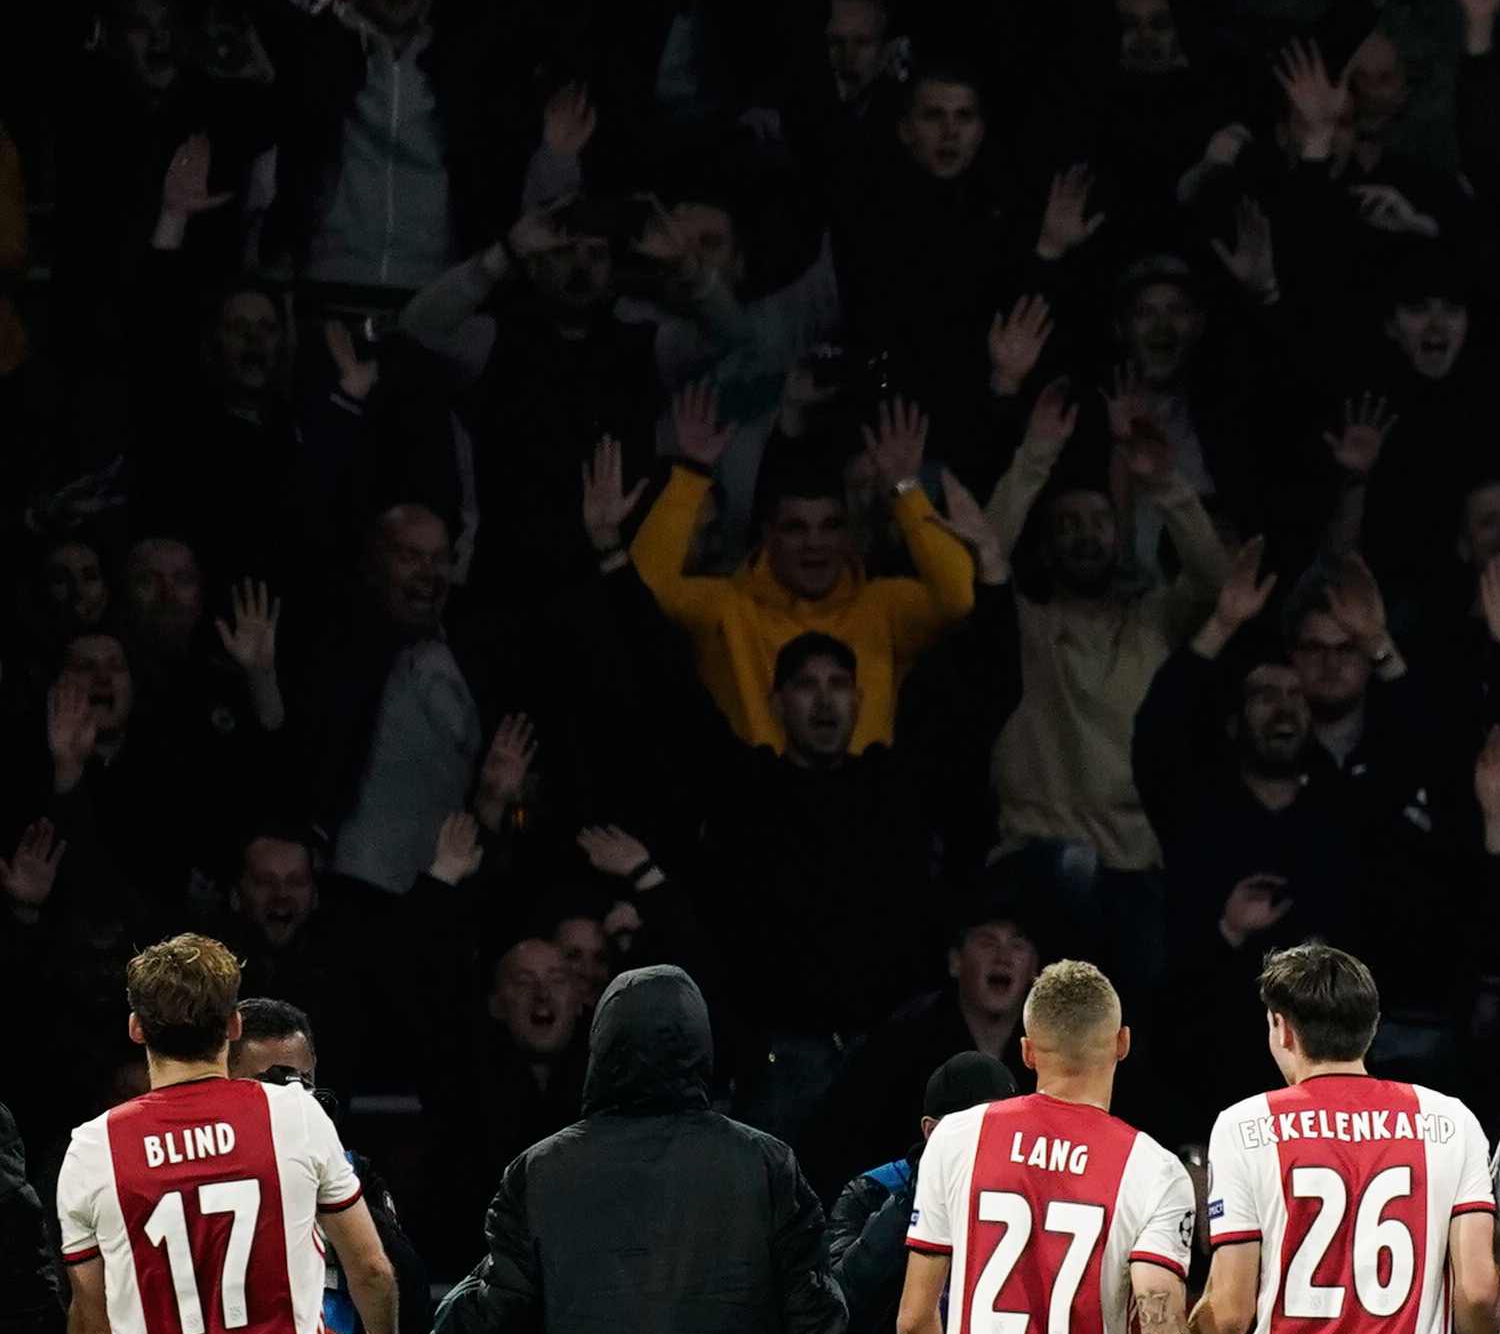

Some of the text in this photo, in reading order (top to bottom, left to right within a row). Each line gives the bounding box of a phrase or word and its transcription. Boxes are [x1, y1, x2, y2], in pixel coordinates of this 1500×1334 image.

[143, 1121, 237, 1168] BLIND
[1238, 1108, 1456, 1150] EKKELENKAMP
[1009, 1130, 1089, 1176] LANG
[1283, 1165, 1415, 1318] 26
